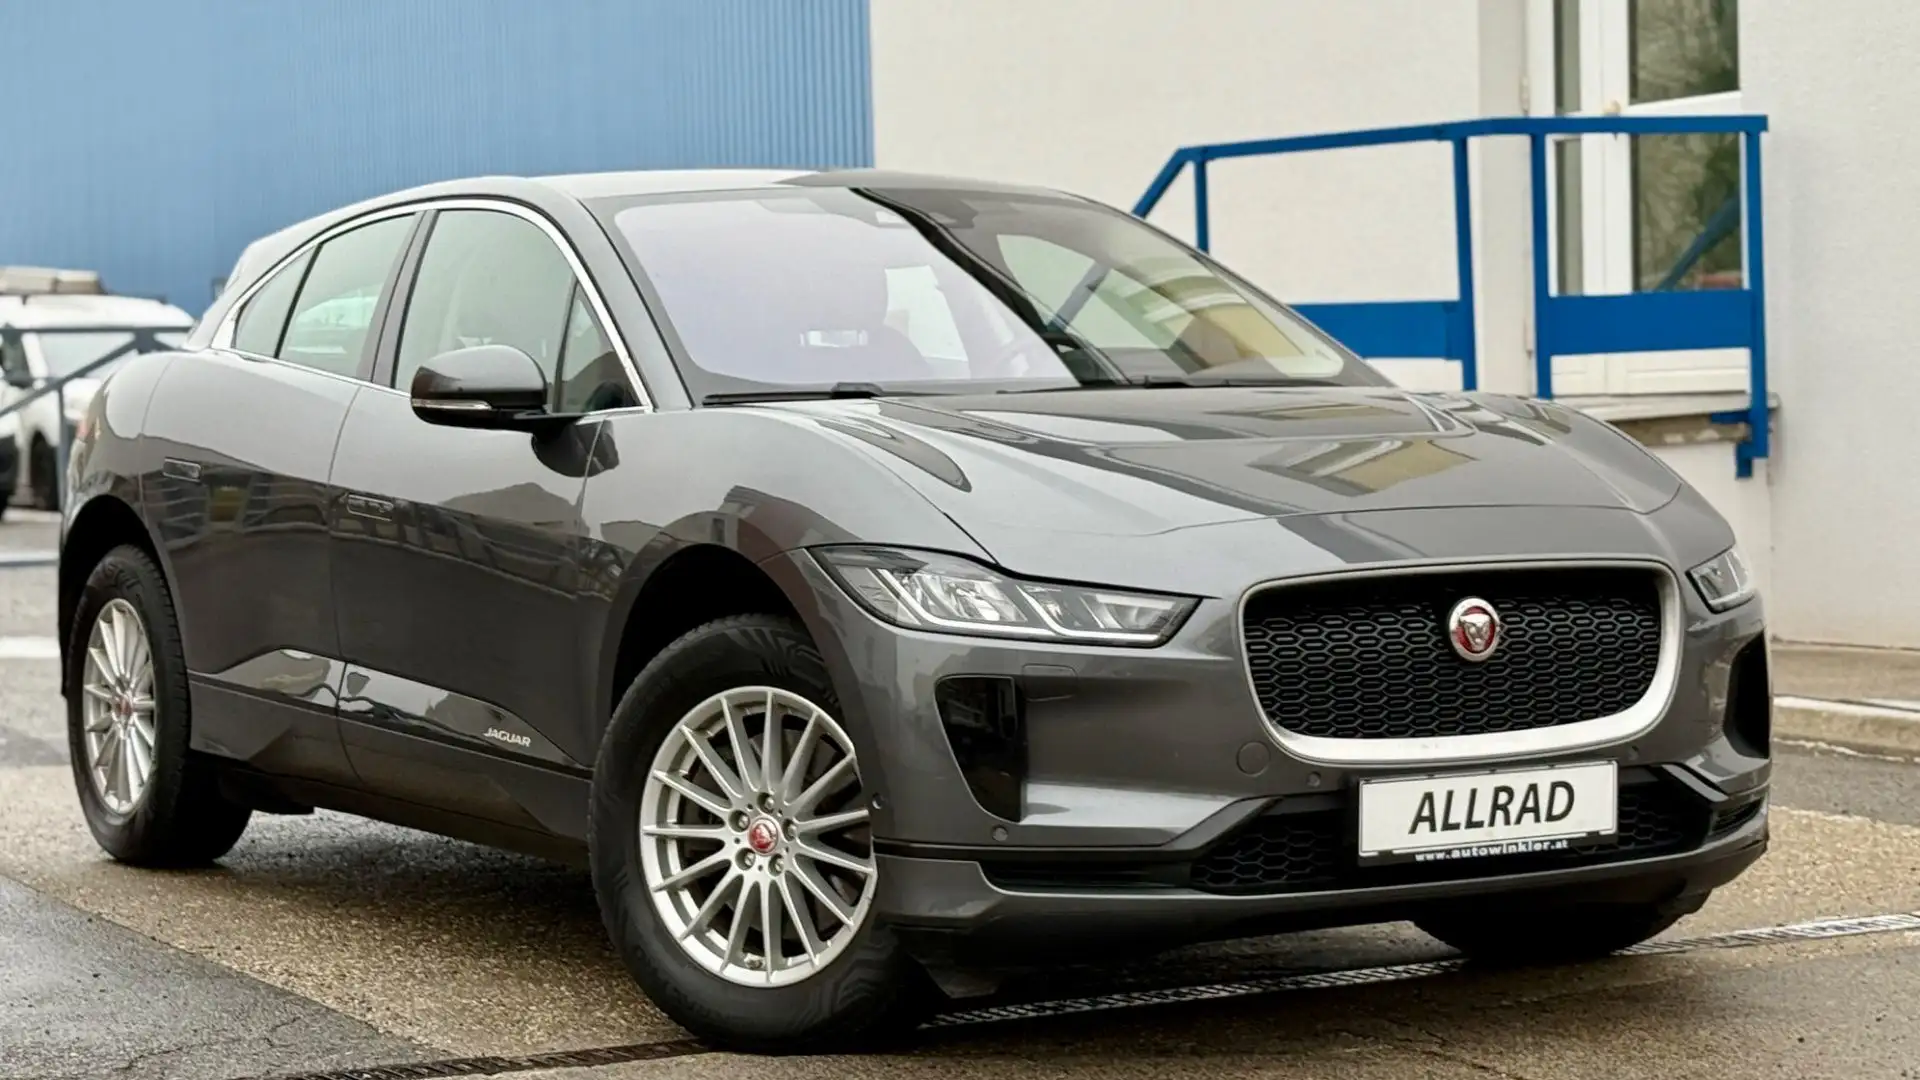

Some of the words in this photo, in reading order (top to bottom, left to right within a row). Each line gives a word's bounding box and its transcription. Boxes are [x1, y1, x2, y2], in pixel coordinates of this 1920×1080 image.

[483, 727, 532, 747] JAGUAR
[1408, 781, 1575, 834] ALLRAD
[1415, 839, 1568, 861] www.autowinkler.at
